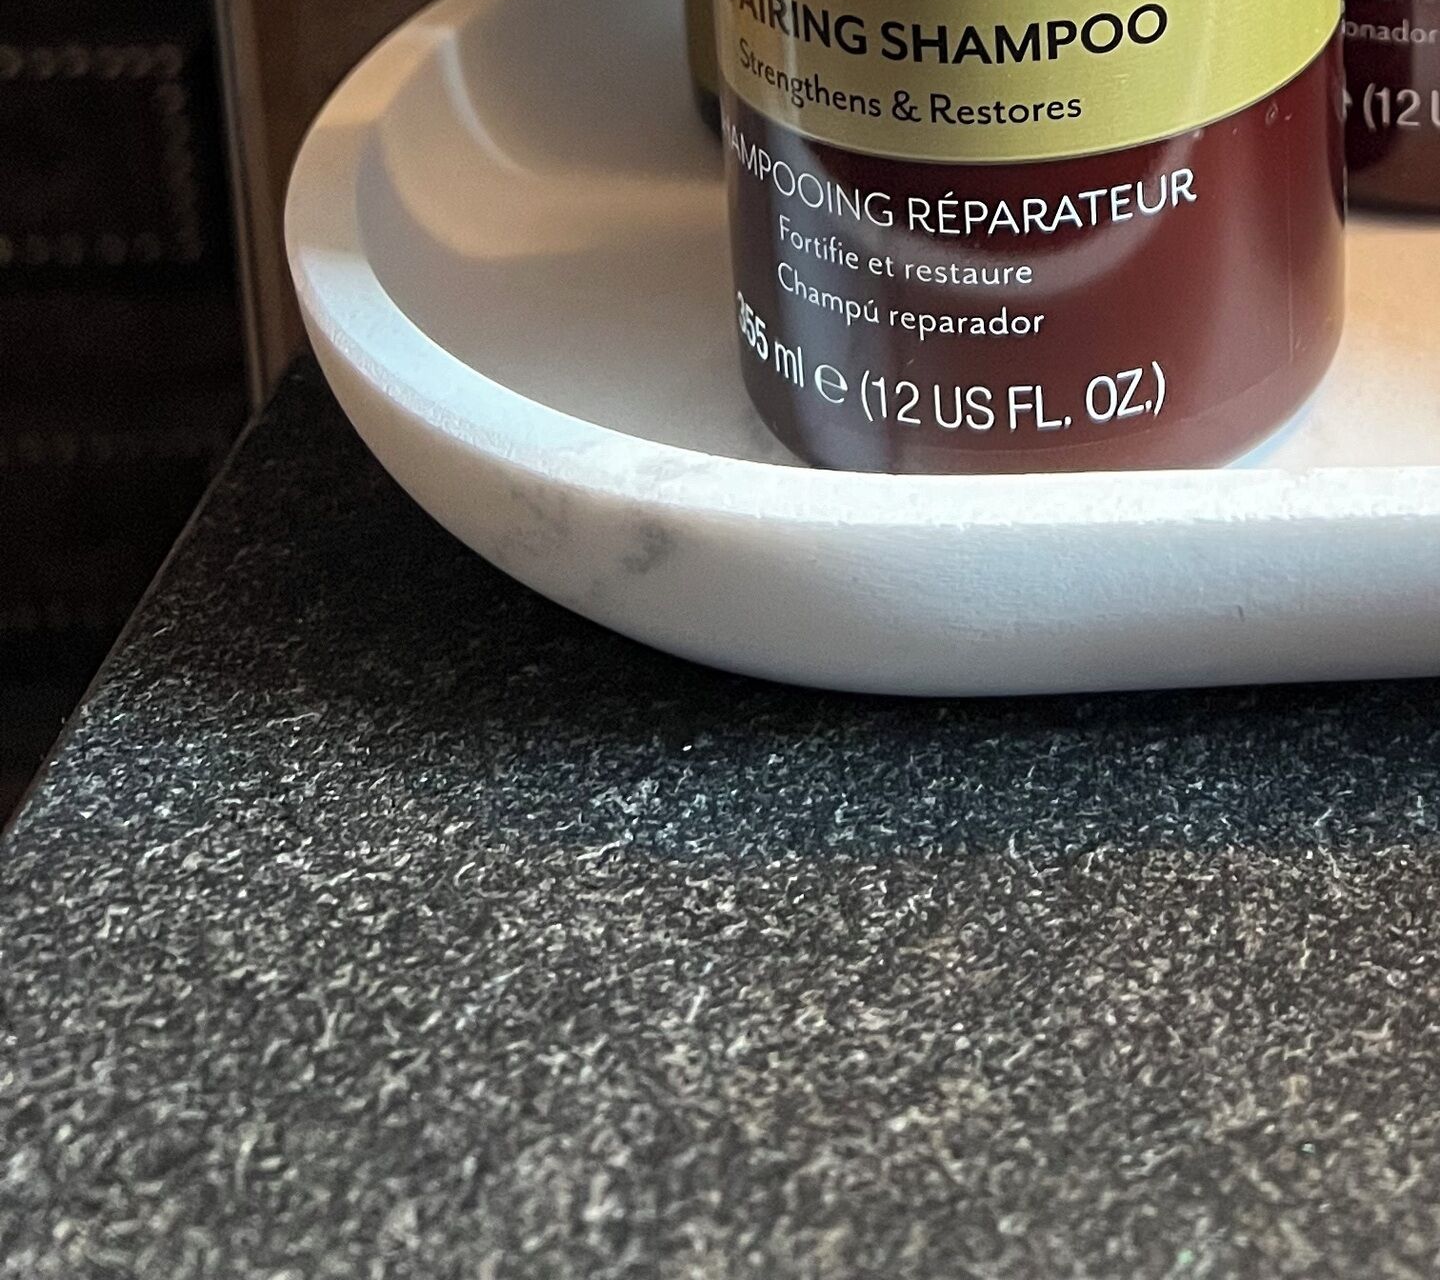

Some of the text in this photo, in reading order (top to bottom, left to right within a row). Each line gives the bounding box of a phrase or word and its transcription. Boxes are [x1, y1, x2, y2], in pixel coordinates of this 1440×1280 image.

[881, 3, 1168, 65] SHAMPOO
[739, 38, 1082, 126] Strengthens & Restores
[1363, 82, 1420, 132] (12
[729, 122, 1197, 235] AMPOOING RÉPARATEUR
[778, 214, 1033, 287] Fortifie et restaure
[778, 262, 1045, 341] Champú reparador
[737, 290, 769, 361] 355
[775, 340, 805, 389] ml
[860, 368, 920, 425] (12
[934, 386, 995, 430] US
[1008, 386, 1071, 431] FL.
[1085, 361, 1167, 424] OZ.)
